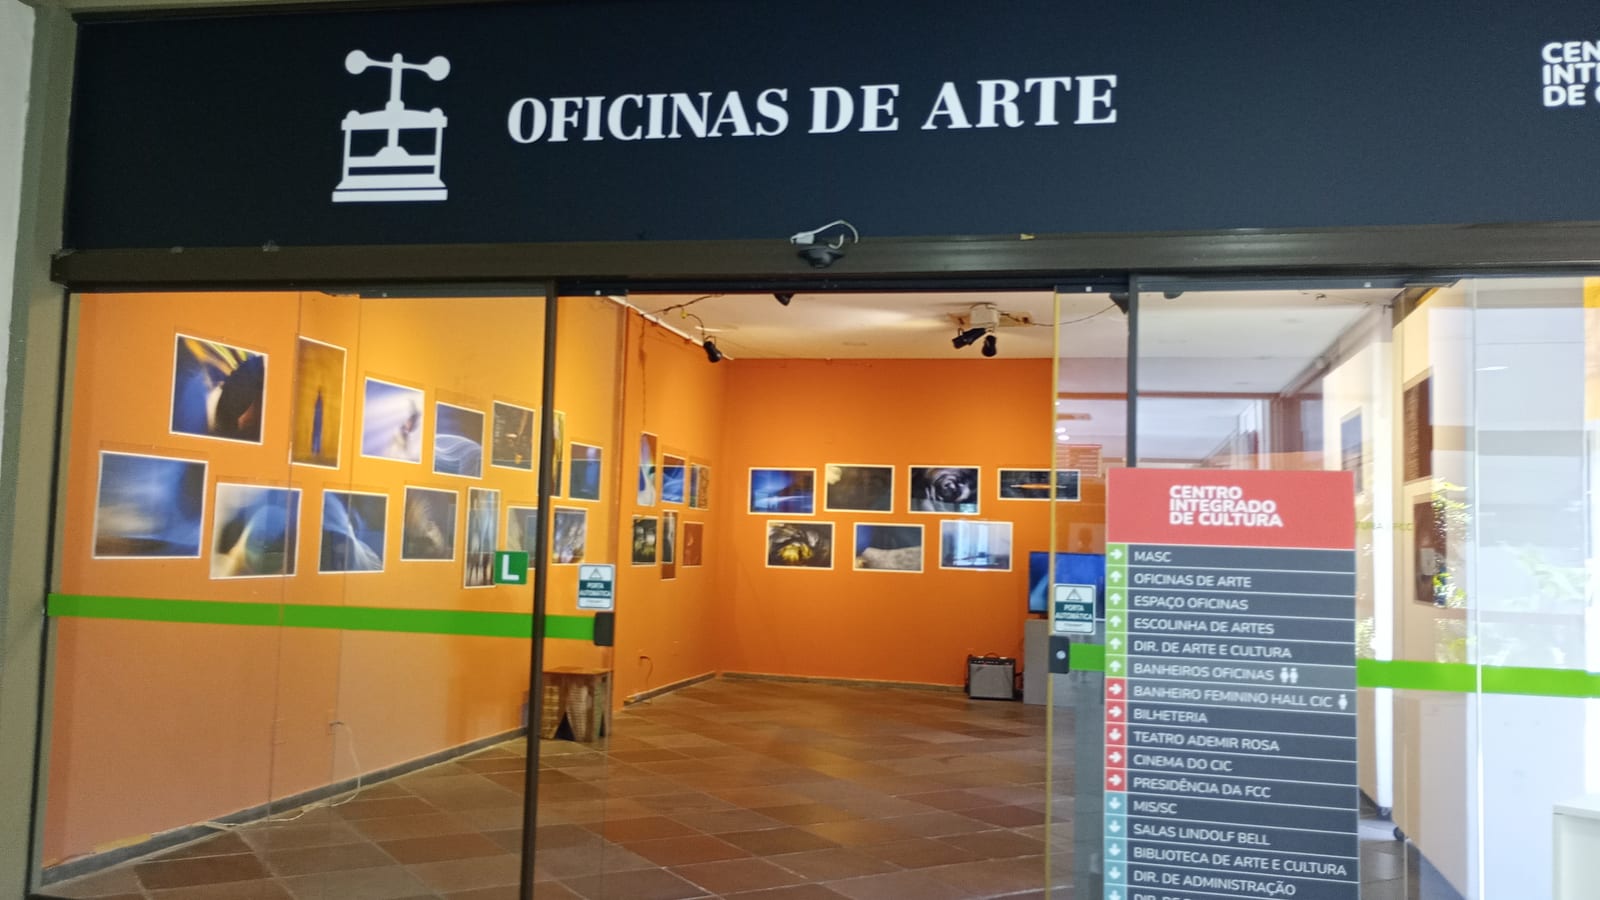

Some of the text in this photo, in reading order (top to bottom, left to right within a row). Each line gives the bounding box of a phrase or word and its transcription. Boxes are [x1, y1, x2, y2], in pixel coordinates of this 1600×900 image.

[1543, 62, 1600, 85] INT
[1543, 84, 1586, 107] DE
[507, 74, 1117, 144] OFICINAS DE ARTE
[1170, 485, 1242, 500] CENTRO
[1170, 499, 1276, 513] INTEGRADO
[1170, 512, 1283, 527] DE CULTURA
[1134, 551, 1172, 562] MASC
[501, 554, 520, 580] L
[1134, 573, 1252, 588] OFICINAS DE ARTE
[1134, 596, 1248, 610] ESPAÇO OFICINAS
[1134, 618, 1274, 634] ESCOLINHA DE ARTES
[1134, 640, 1292, 658] DIR. DE ARTE E CULTURA
[1134, 663, 1274, 680] BANHEIROS OFICINAS
[1134, 686, 1332, 708] BANHEIRO FEMININO HALL CIC
[1134, 709, 1208, 723] BILHETERIA
[1134, 732, 1280, 751] TEATRO ADEMIR ROSA
[1134, 754, 1232, 771] CINEMA DO CIC
[1134, 777, 1271, 798] PRESIDÊNCIA DA FCC
[1134, 800, 1177, 814] MIS/SC
[1134, 824, 1270, 845] SALAS LINDOLF BELL
[1134, 847, 1346, 876] BIBLIOTECA DE ARTE E CULTURA
[1134, 870, 1296, 896] DIR. DE ADMINISTRAÇÃO
